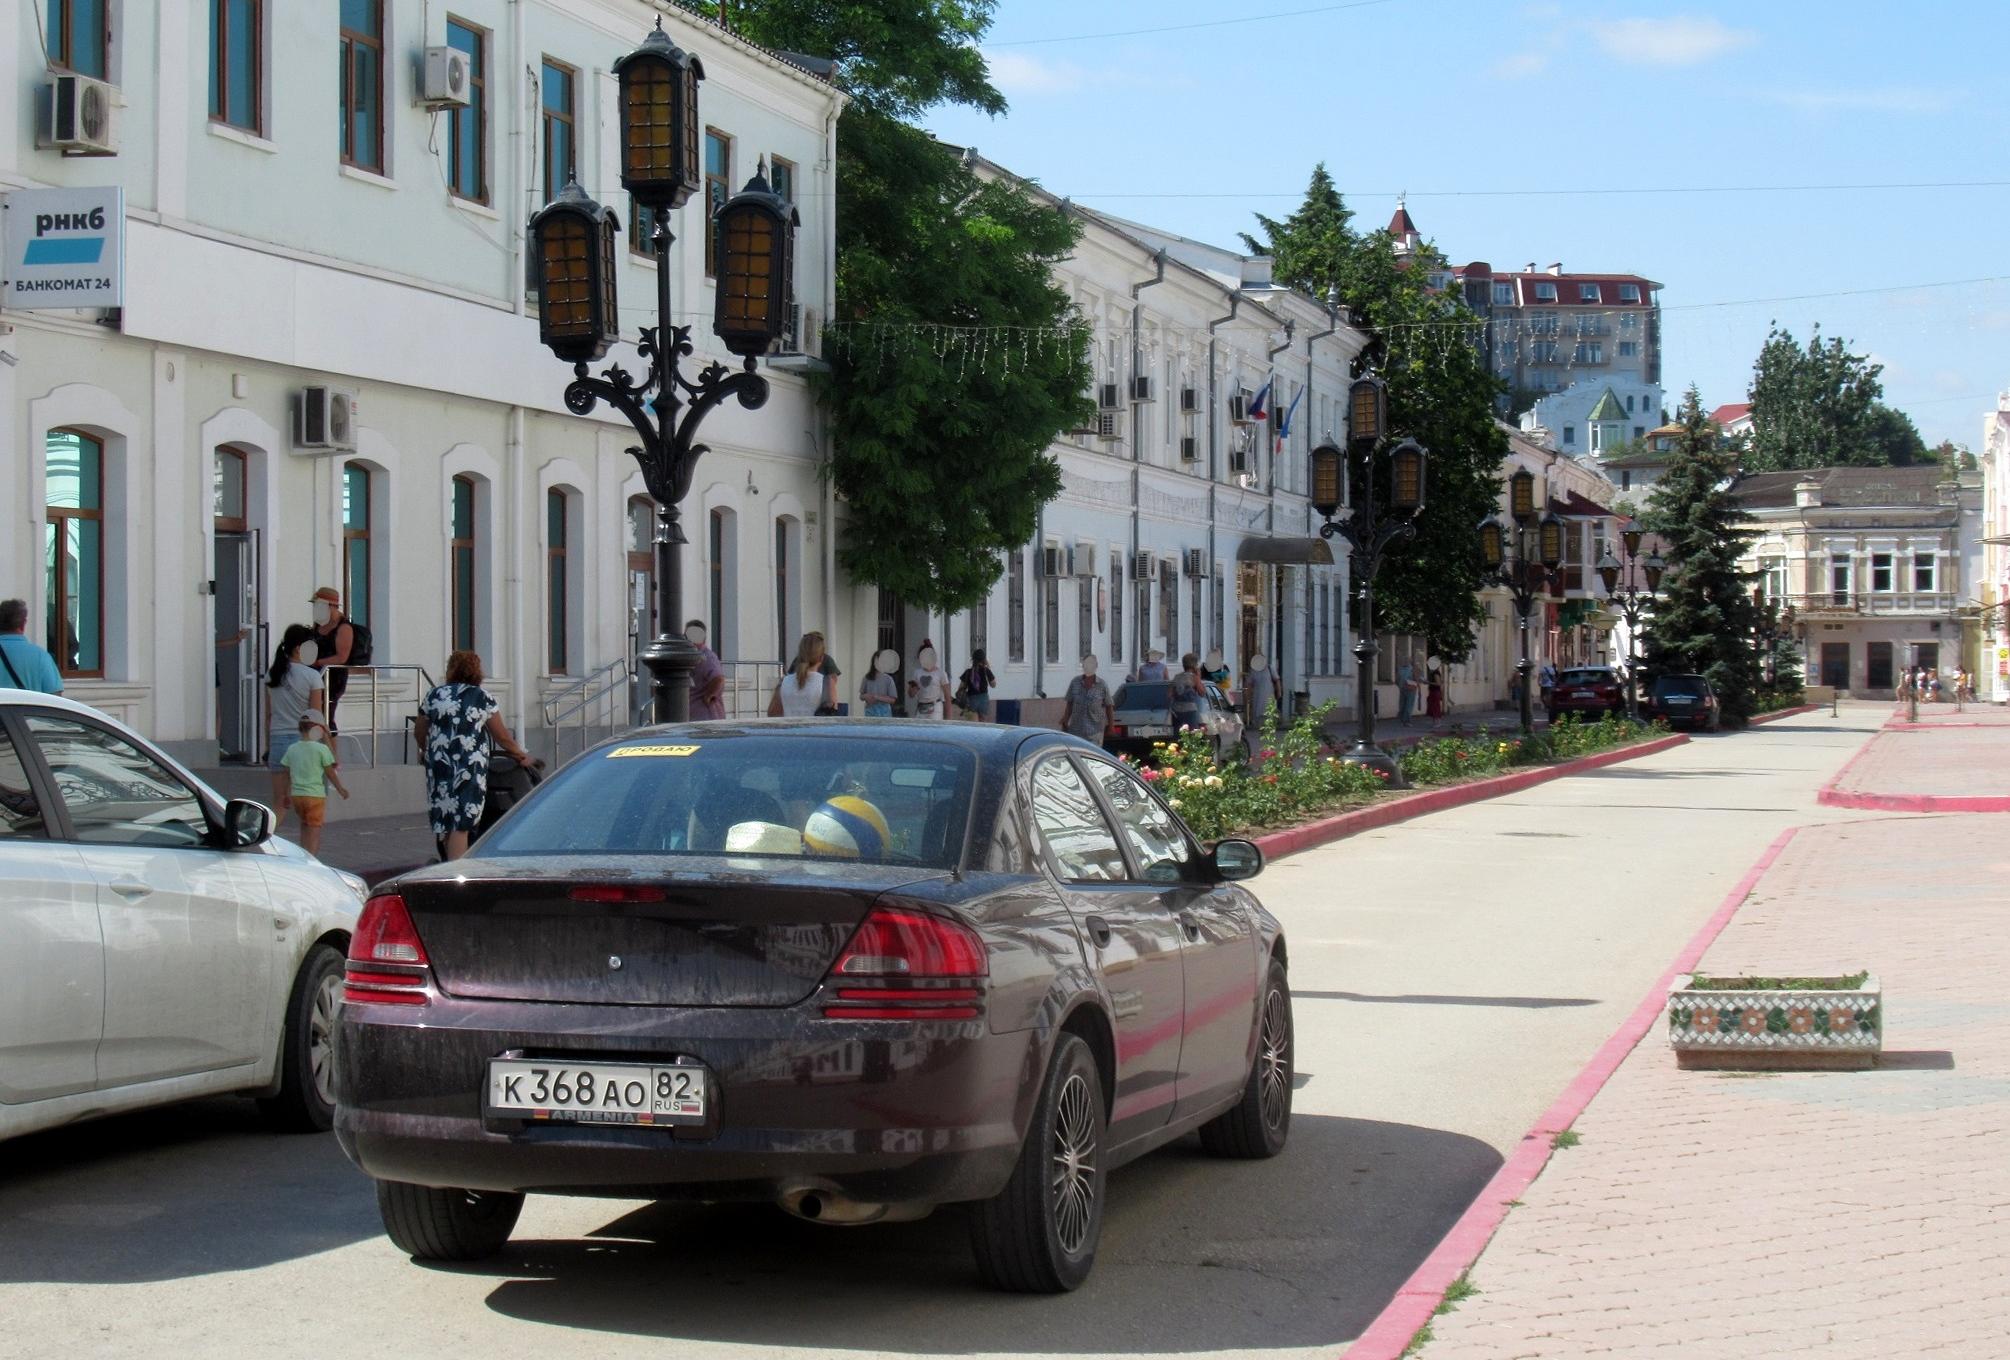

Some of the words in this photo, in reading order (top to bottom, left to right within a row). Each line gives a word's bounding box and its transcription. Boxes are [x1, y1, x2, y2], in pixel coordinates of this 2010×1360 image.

[36, 206, 105, 237] рнкб
[16, 279, 92, 292] БАНКОМАТ
[95, 278, 111, 289] 24
[656, 1072, 691, 1100] 82
[654, 1101, 680, 1111] RUS
[551, 1110, 635, 1122] ARMENIA
